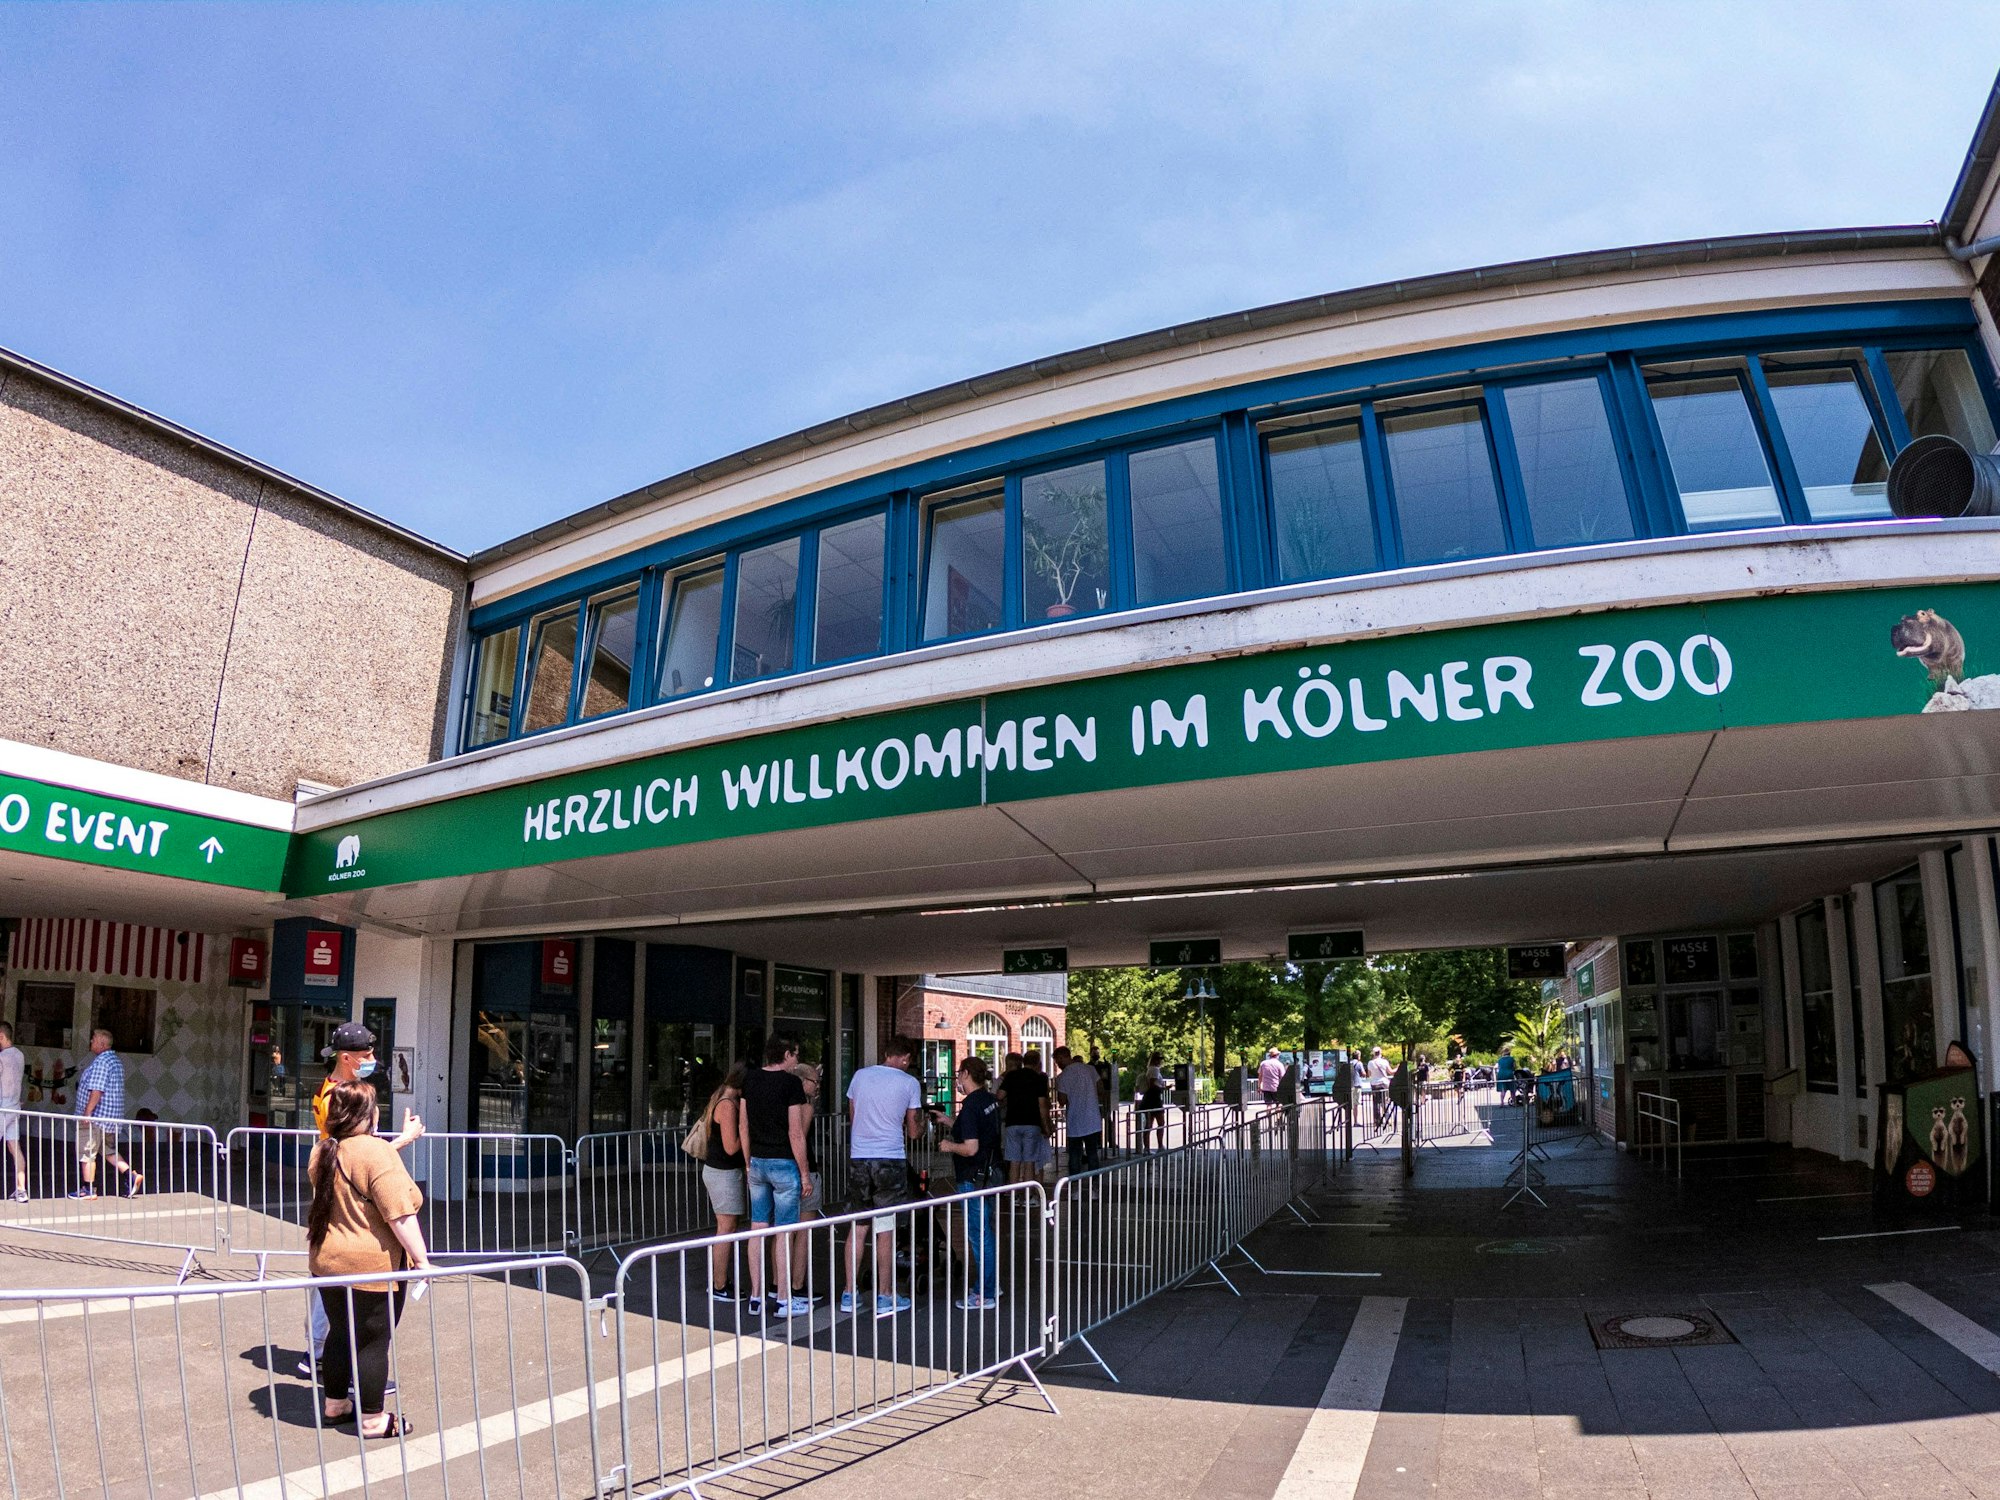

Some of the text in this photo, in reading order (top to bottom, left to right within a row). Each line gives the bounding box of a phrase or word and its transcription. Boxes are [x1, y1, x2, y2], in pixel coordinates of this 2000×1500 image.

[523, 634, 1733, 843] HERZLICH WILLKOMMEN IM KÖLNER ZOO
[45, 801, 170, 858] EVENT
[328, 869, 366, 882] KÖLNER ZOO
[1520, 948, 1552, 959] KASSE
[1671, 941, 1710, 953] KASSE
[1532, 958, 1541, 969] 6
[1686, 954, 1697, 969] 5
